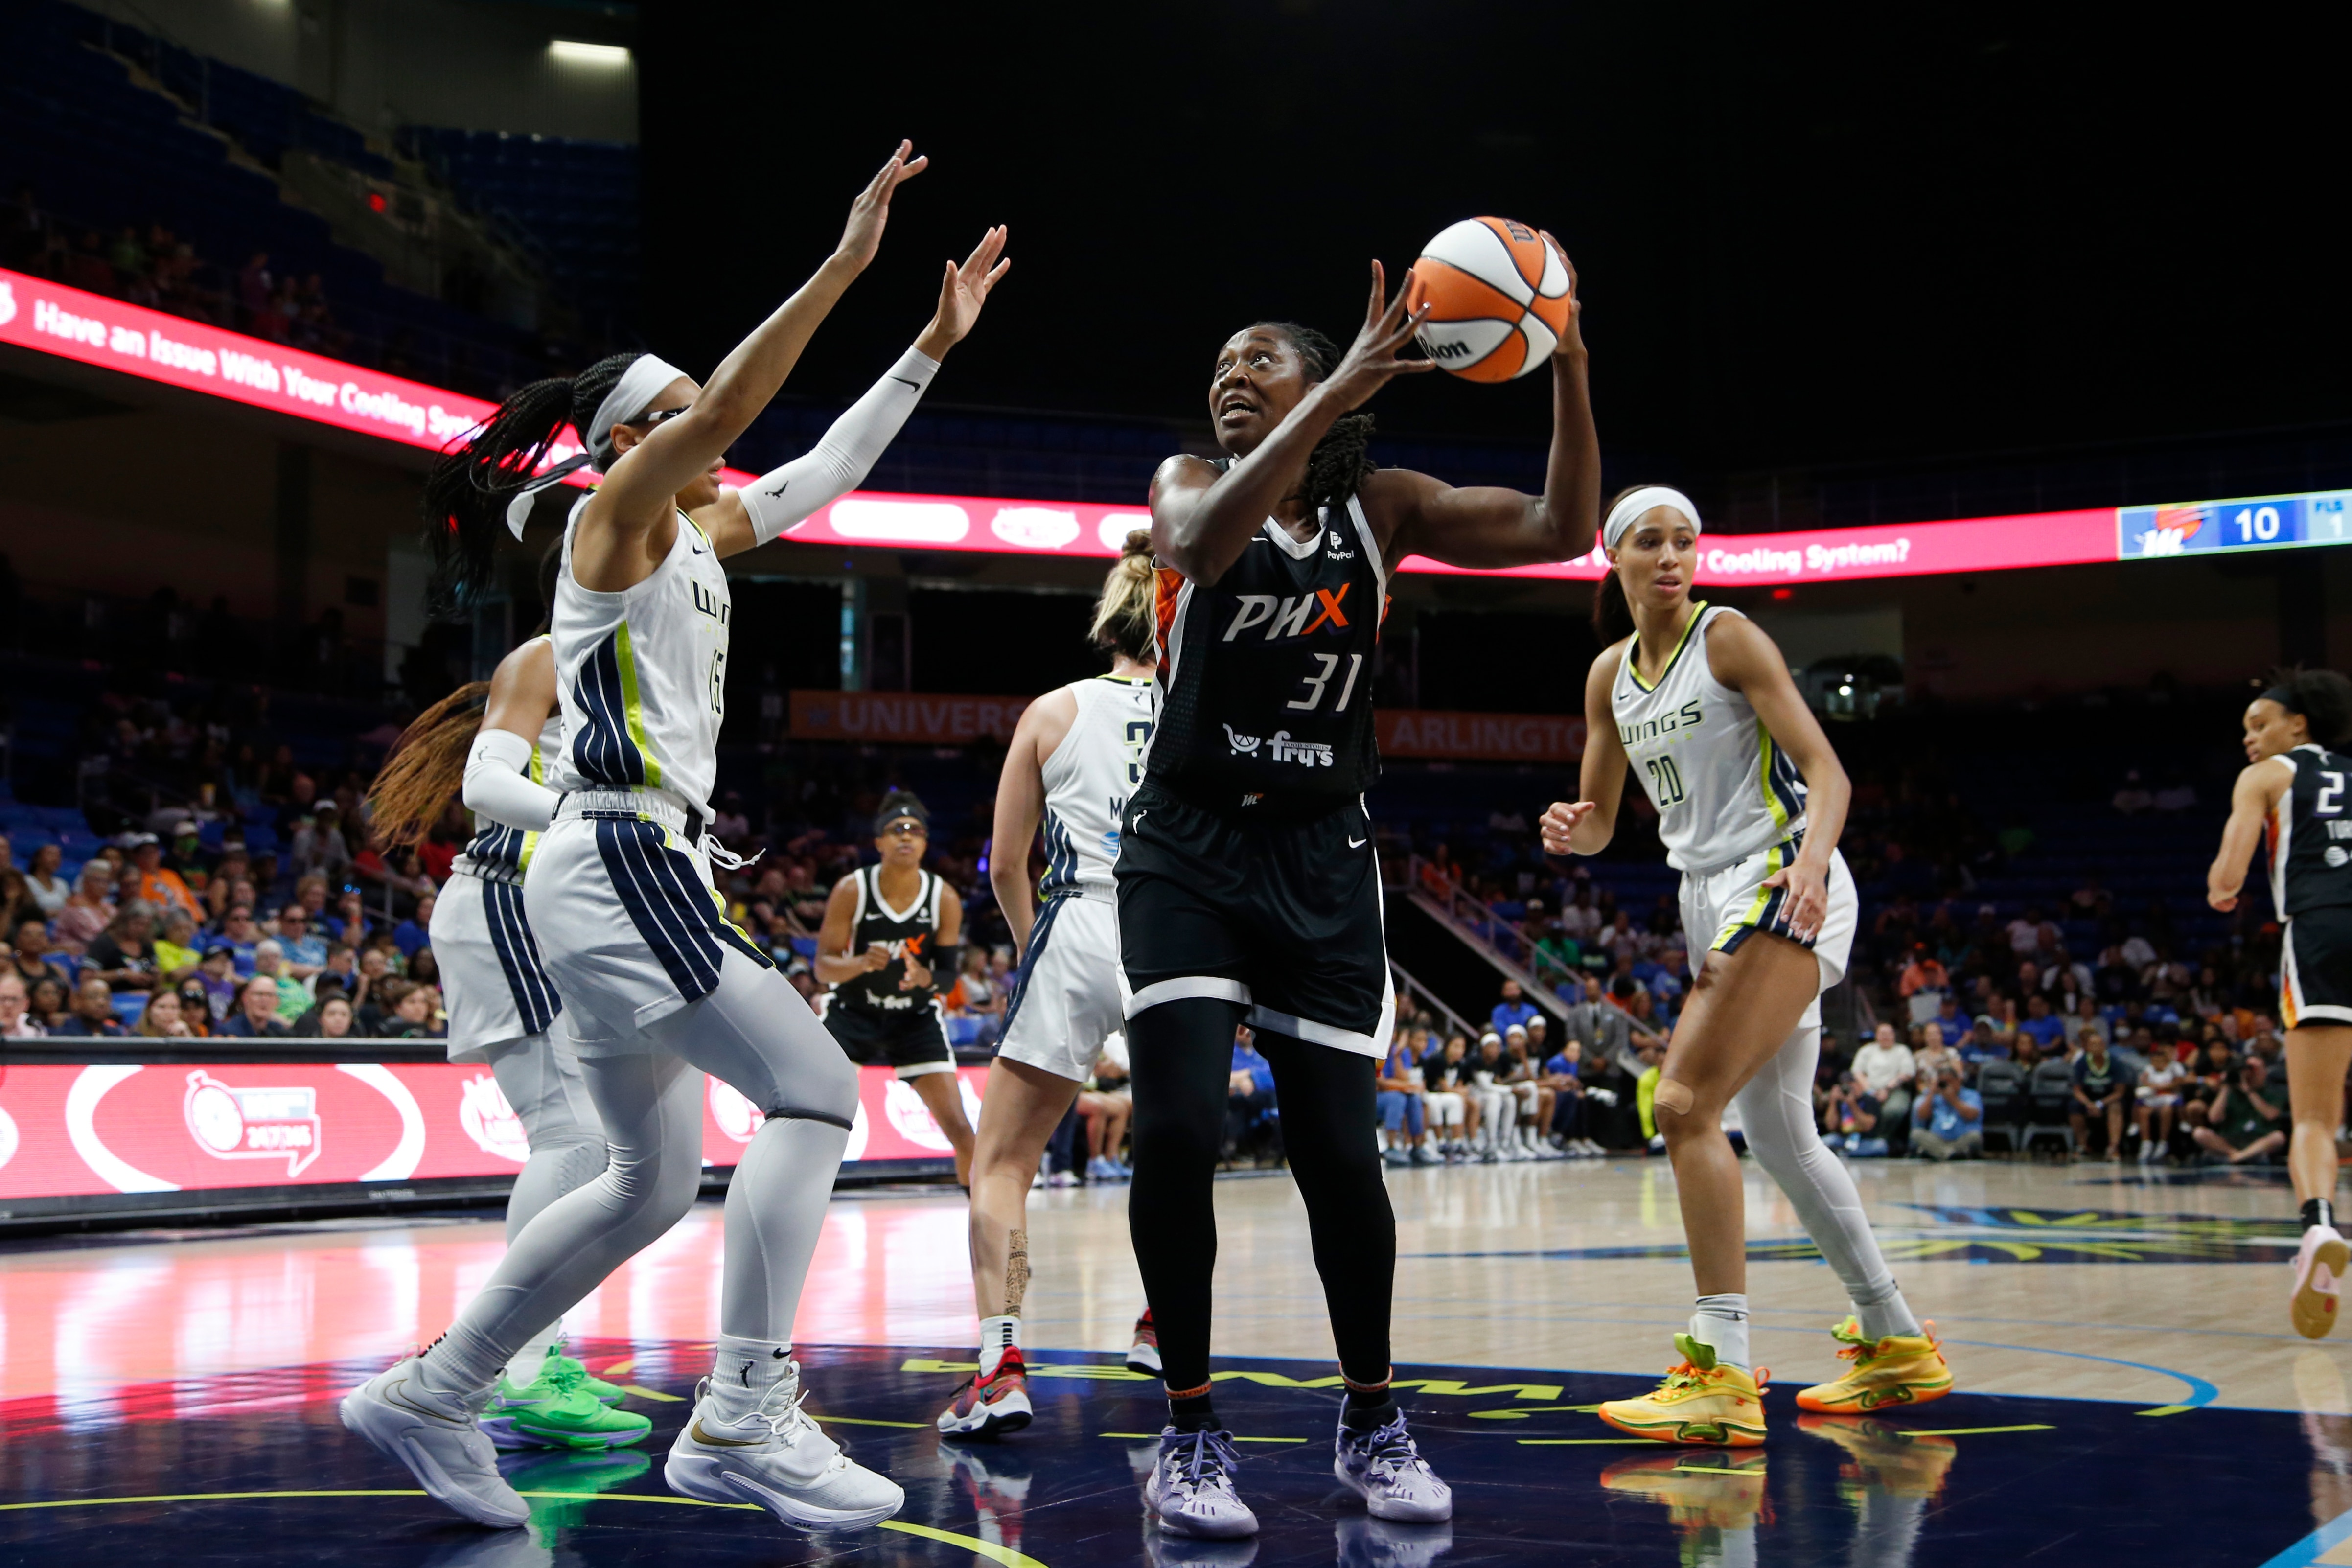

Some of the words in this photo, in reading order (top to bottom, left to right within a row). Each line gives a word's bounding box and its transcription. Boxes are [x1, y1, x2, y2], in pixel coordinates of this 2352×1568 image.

[34, 298, 107, 347] Have
[110, 325, 146, 358] an
[150, 330, 216, 376] Issue
[219, 347, 280, 393] With
[282, 365, 338, 407] Your
[340, 381, 427, 437] Cooling
[2234, 506, 2280, 542] 10
[1327, 549, 1355, 561] PayPal
[1706, 546, 1802, 575] Cooling
[1806, 538, 1911, 573] System?
[1222, 582, 1351, 642] PHX
[1286, 652, 1363, 713] 31
[1265, 730, 1333, 767] fry's
[1647, 755, 1685, 809] 20
